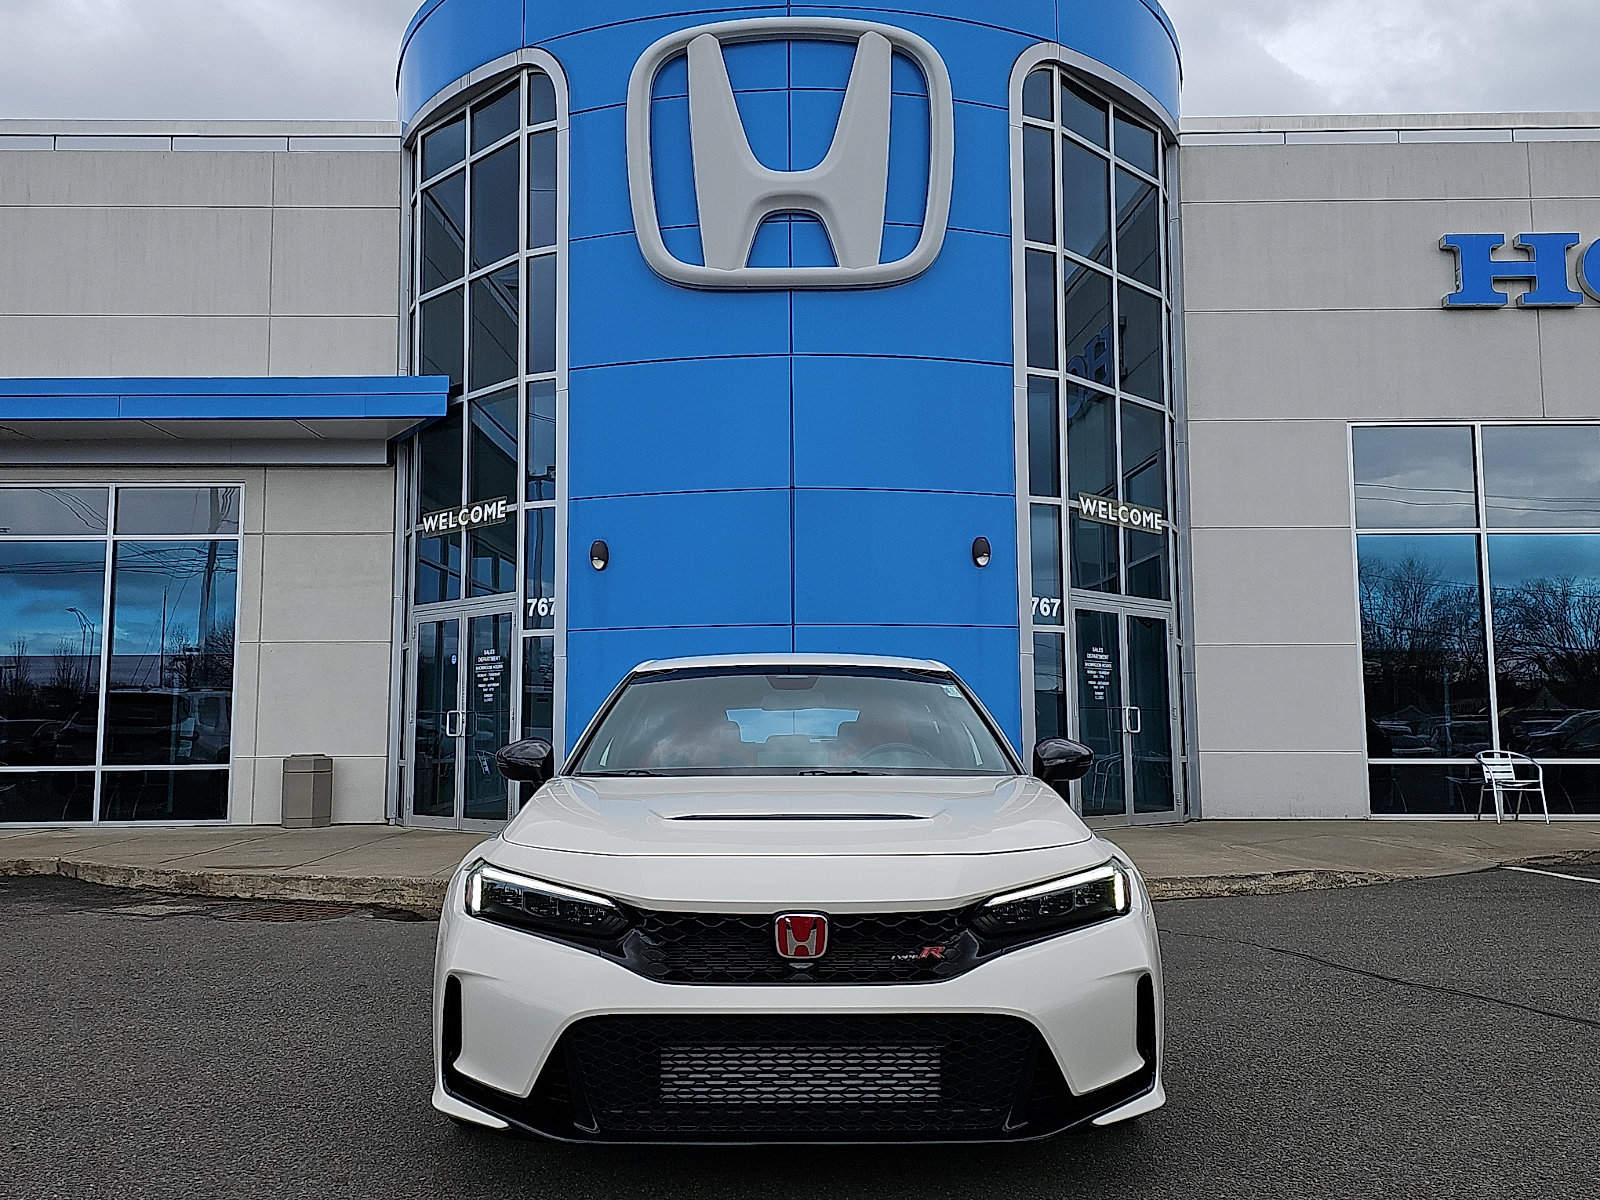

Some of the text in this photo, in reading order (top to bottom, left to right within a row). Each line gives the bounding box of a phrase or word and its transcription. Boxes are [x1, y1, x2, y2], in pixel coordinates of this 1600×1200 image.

[1439, 232, 1600, 309] H
[422, 499, 508, 533] WELCOME
[1079, 496, 1163, 531] WELCOME
[526, 597, 556, 617] 767
[1031, 596, 1061, 617] 767
[919, 946, 946, 959] R
